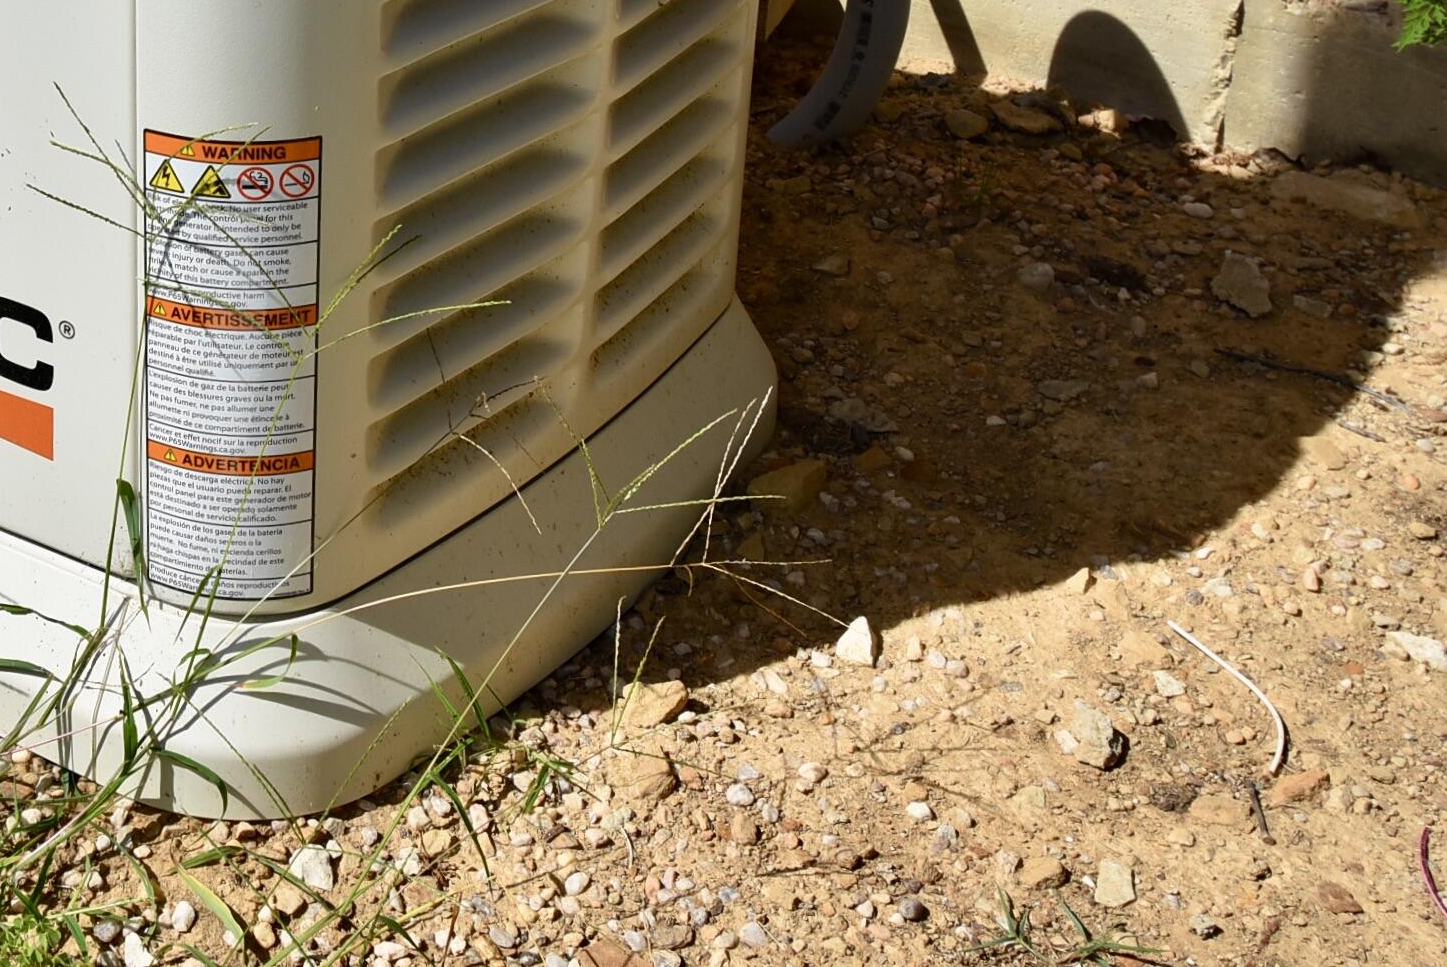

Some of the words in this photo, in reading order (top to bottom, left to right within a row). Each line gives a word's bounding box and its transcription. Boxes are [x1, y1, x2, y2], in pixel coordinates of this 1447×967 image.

[202, 145, 286, 160] WARNING
[263, 202, 308, 212] serviceable
[266, 214, 276, 222] for
[182, 230, 191, 239] by
[193, 232, 228, 242] qualified
[261, 233, 303, 244] personnel.
[272, 224, 290, 234] only
[172, 252, 194, 263] injury
[174, 264, 199, 272] match
[200, 276, 230, 286] battery
[173, 325, 183, 333] de
[149, 338, 180, 352] panneau
[181, 346, 191, 354] de
[203, 349, 250, 360] générateur
[251, 351, 260, 360] de
[262, 350, 291, 359] moteur
[184, 337, 196, 346] par
[149, 348, 174, 360] destiné
[224, 362, 273, 372] uniquement
[275, 362, 288, 370] par
[149, 358, 184, 372] personnel
[149, 381, 172, 392] causer
[173, 388, 187, 396] des
[188, 389, 224, 402] blessures
[225, 394, 252, 403] graves
[266, 394, 273, 402] la
[189, 380, 199, 388] de
[201, 383, 214, 391] gaz
[216, 384, 226, 392] de
[238, 384, 269, 392] batterie
[149, 390, 159, 398] Ne
[160, 394, 173, 403] pas
[211, 404, 225, 412] pas
[149, 400, 182, 415] allumette
[192, 411, 232, 423] provoquer
[184, 419, 193, 428] de
[204, 423, 261, 434] compartiment
[183, 434, 201, 442] effet
[202, 436, 222, 444] nocif
[182, 454, 300, 472] ADVERTENCIA
[174, 469, 183, 478] de
[184, 472, 219, 484] descarga
[270, 477, 285, 486] hay
[150, 481, 174, 492] control
[175, 488, 196, 498] panel
[197, 493, 214, 503] para
[216, 495, 233, 504] este
[277, 494, 287, 503] de
[289, 492, 311, 501] motor
[172, 478, 186, 488] que
[188, 480, 195, 488] el
[196, 484, 225, 494] usuario
[253, 486, 283, 496] reparar.
[284, 484, 292, 492] El
[150, 498, 162, 508] por
[163, 502, 194, 516] personal
[195, 510, 205, 518] de
[165, 494, 201, 508] destinado
[258, 503, 298, 514] solamente
[150, 512, 158, 520] La
[159, 514, 191, 530] explosión
[192, 524, 202, 532] de
[203, 526, 213, 534] los
[257, 528, 283, 536] batería
[150, 522, 171, 533] puede
[172, 528, 194, 540] causar
[195, 534, 218, 545] daños
[175, 548, 201, 561] chispas
[202, 556, 212, 564] en
[213, 556, 219, 564] la
[258, 558, 268, 566] de
[178, 540, 188, 549] No
[256, 548, 282, 557] cerillos
[150, 551, 204, 572] compartimiento
[150, 564, 178, 579] Produce
